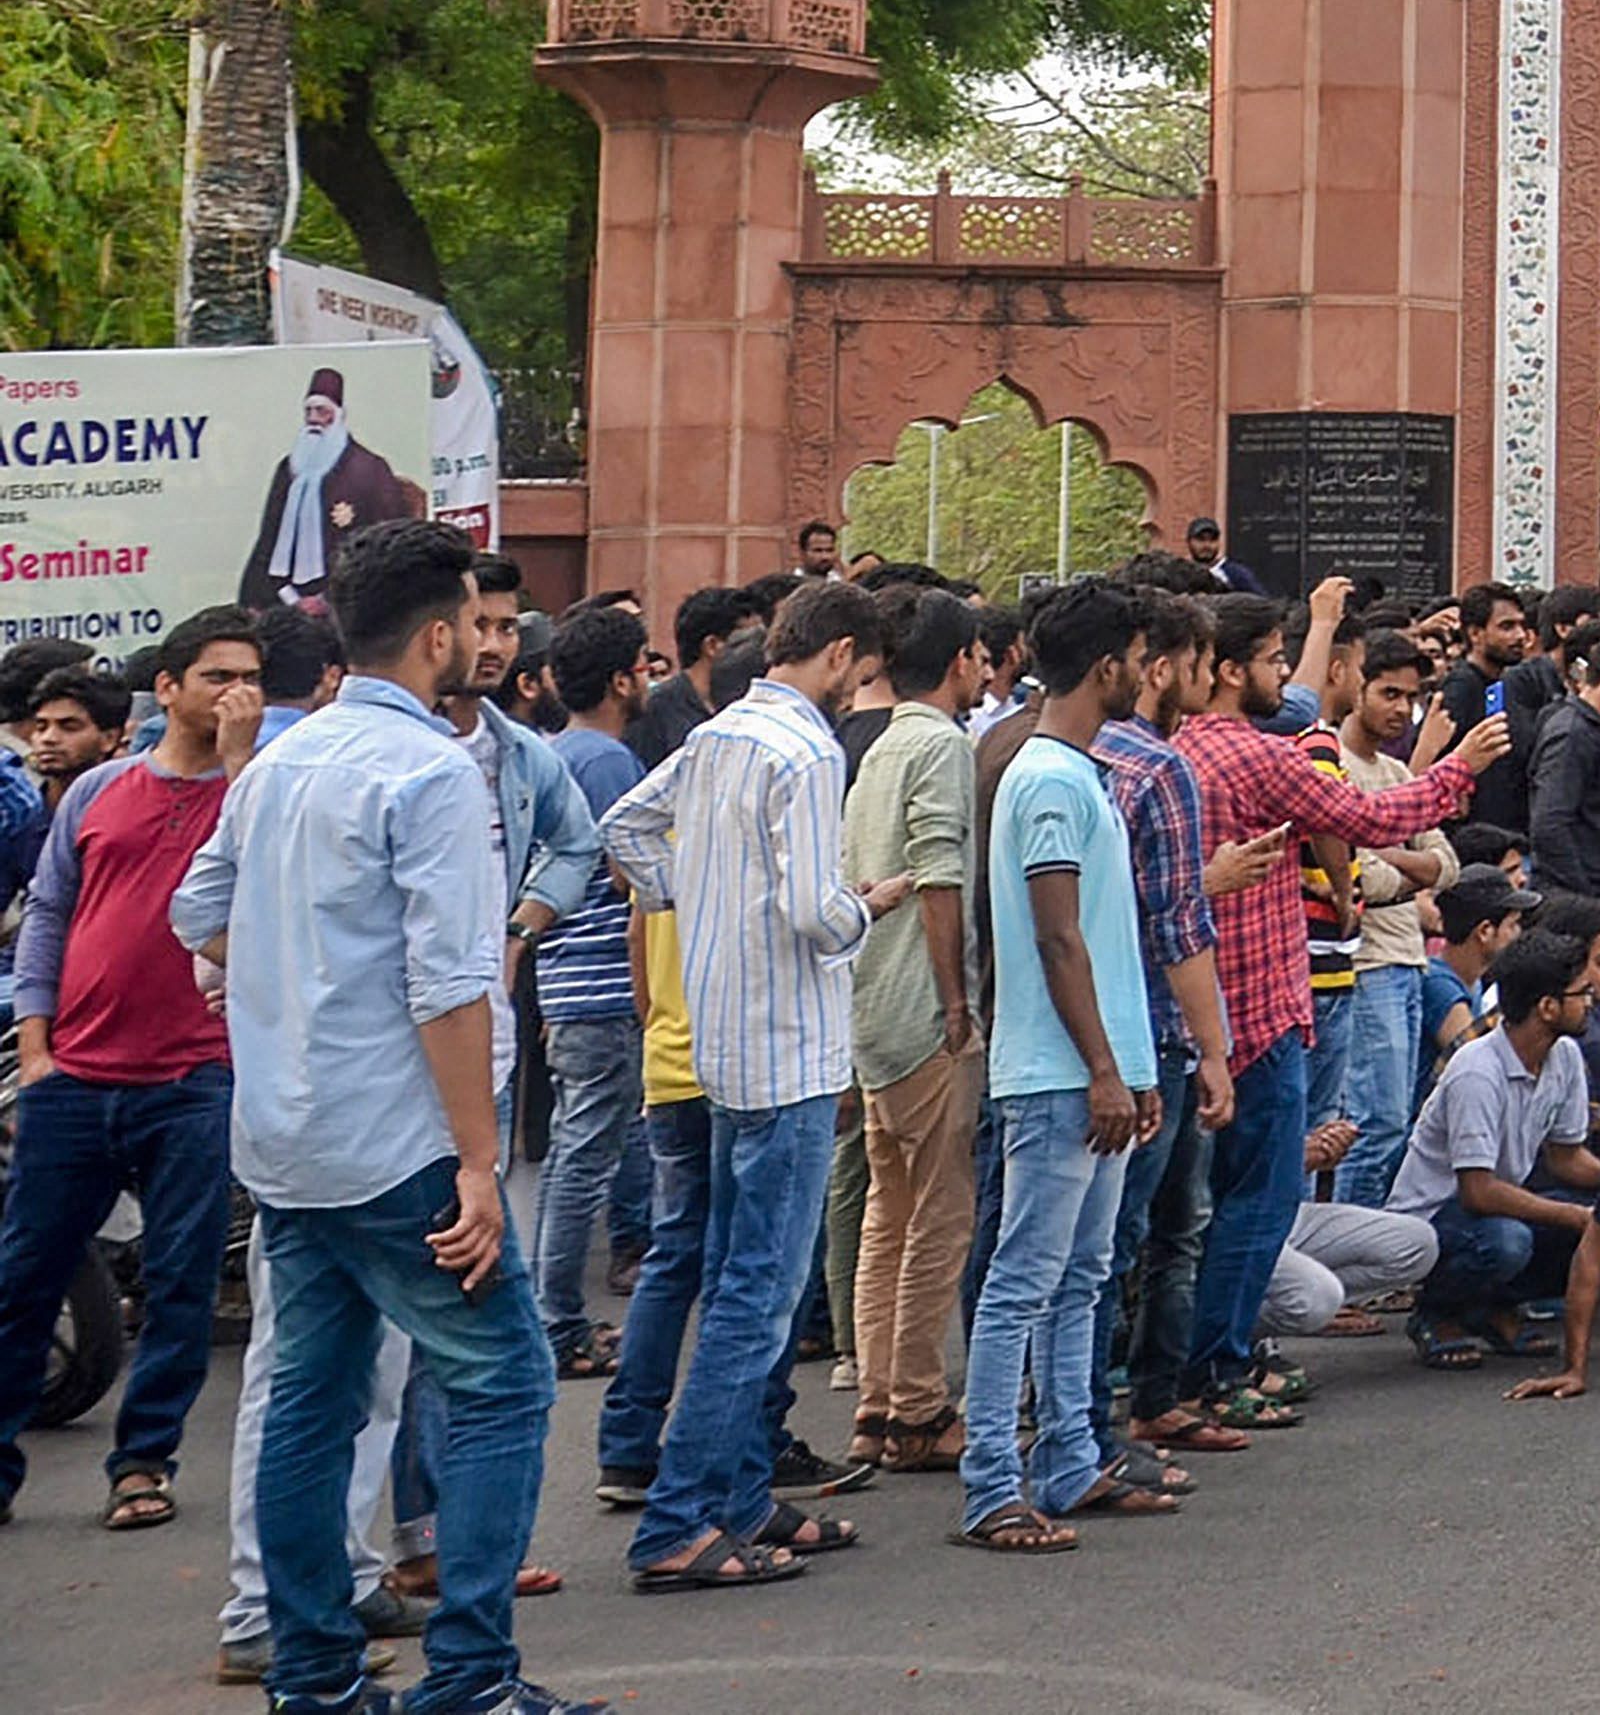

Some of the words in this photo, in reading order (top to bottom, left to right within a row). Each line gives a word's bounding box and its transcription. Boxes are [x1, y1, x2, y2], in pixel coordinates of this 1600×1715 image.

[0, 415, 209, 467] CADEMY
[80, 478, 163, 499] ALIGARH
[0, 540, 150, 582] Seminar
[0, 610, 122, 645] RIBUTION
[129, 608, 163, 636] TO
